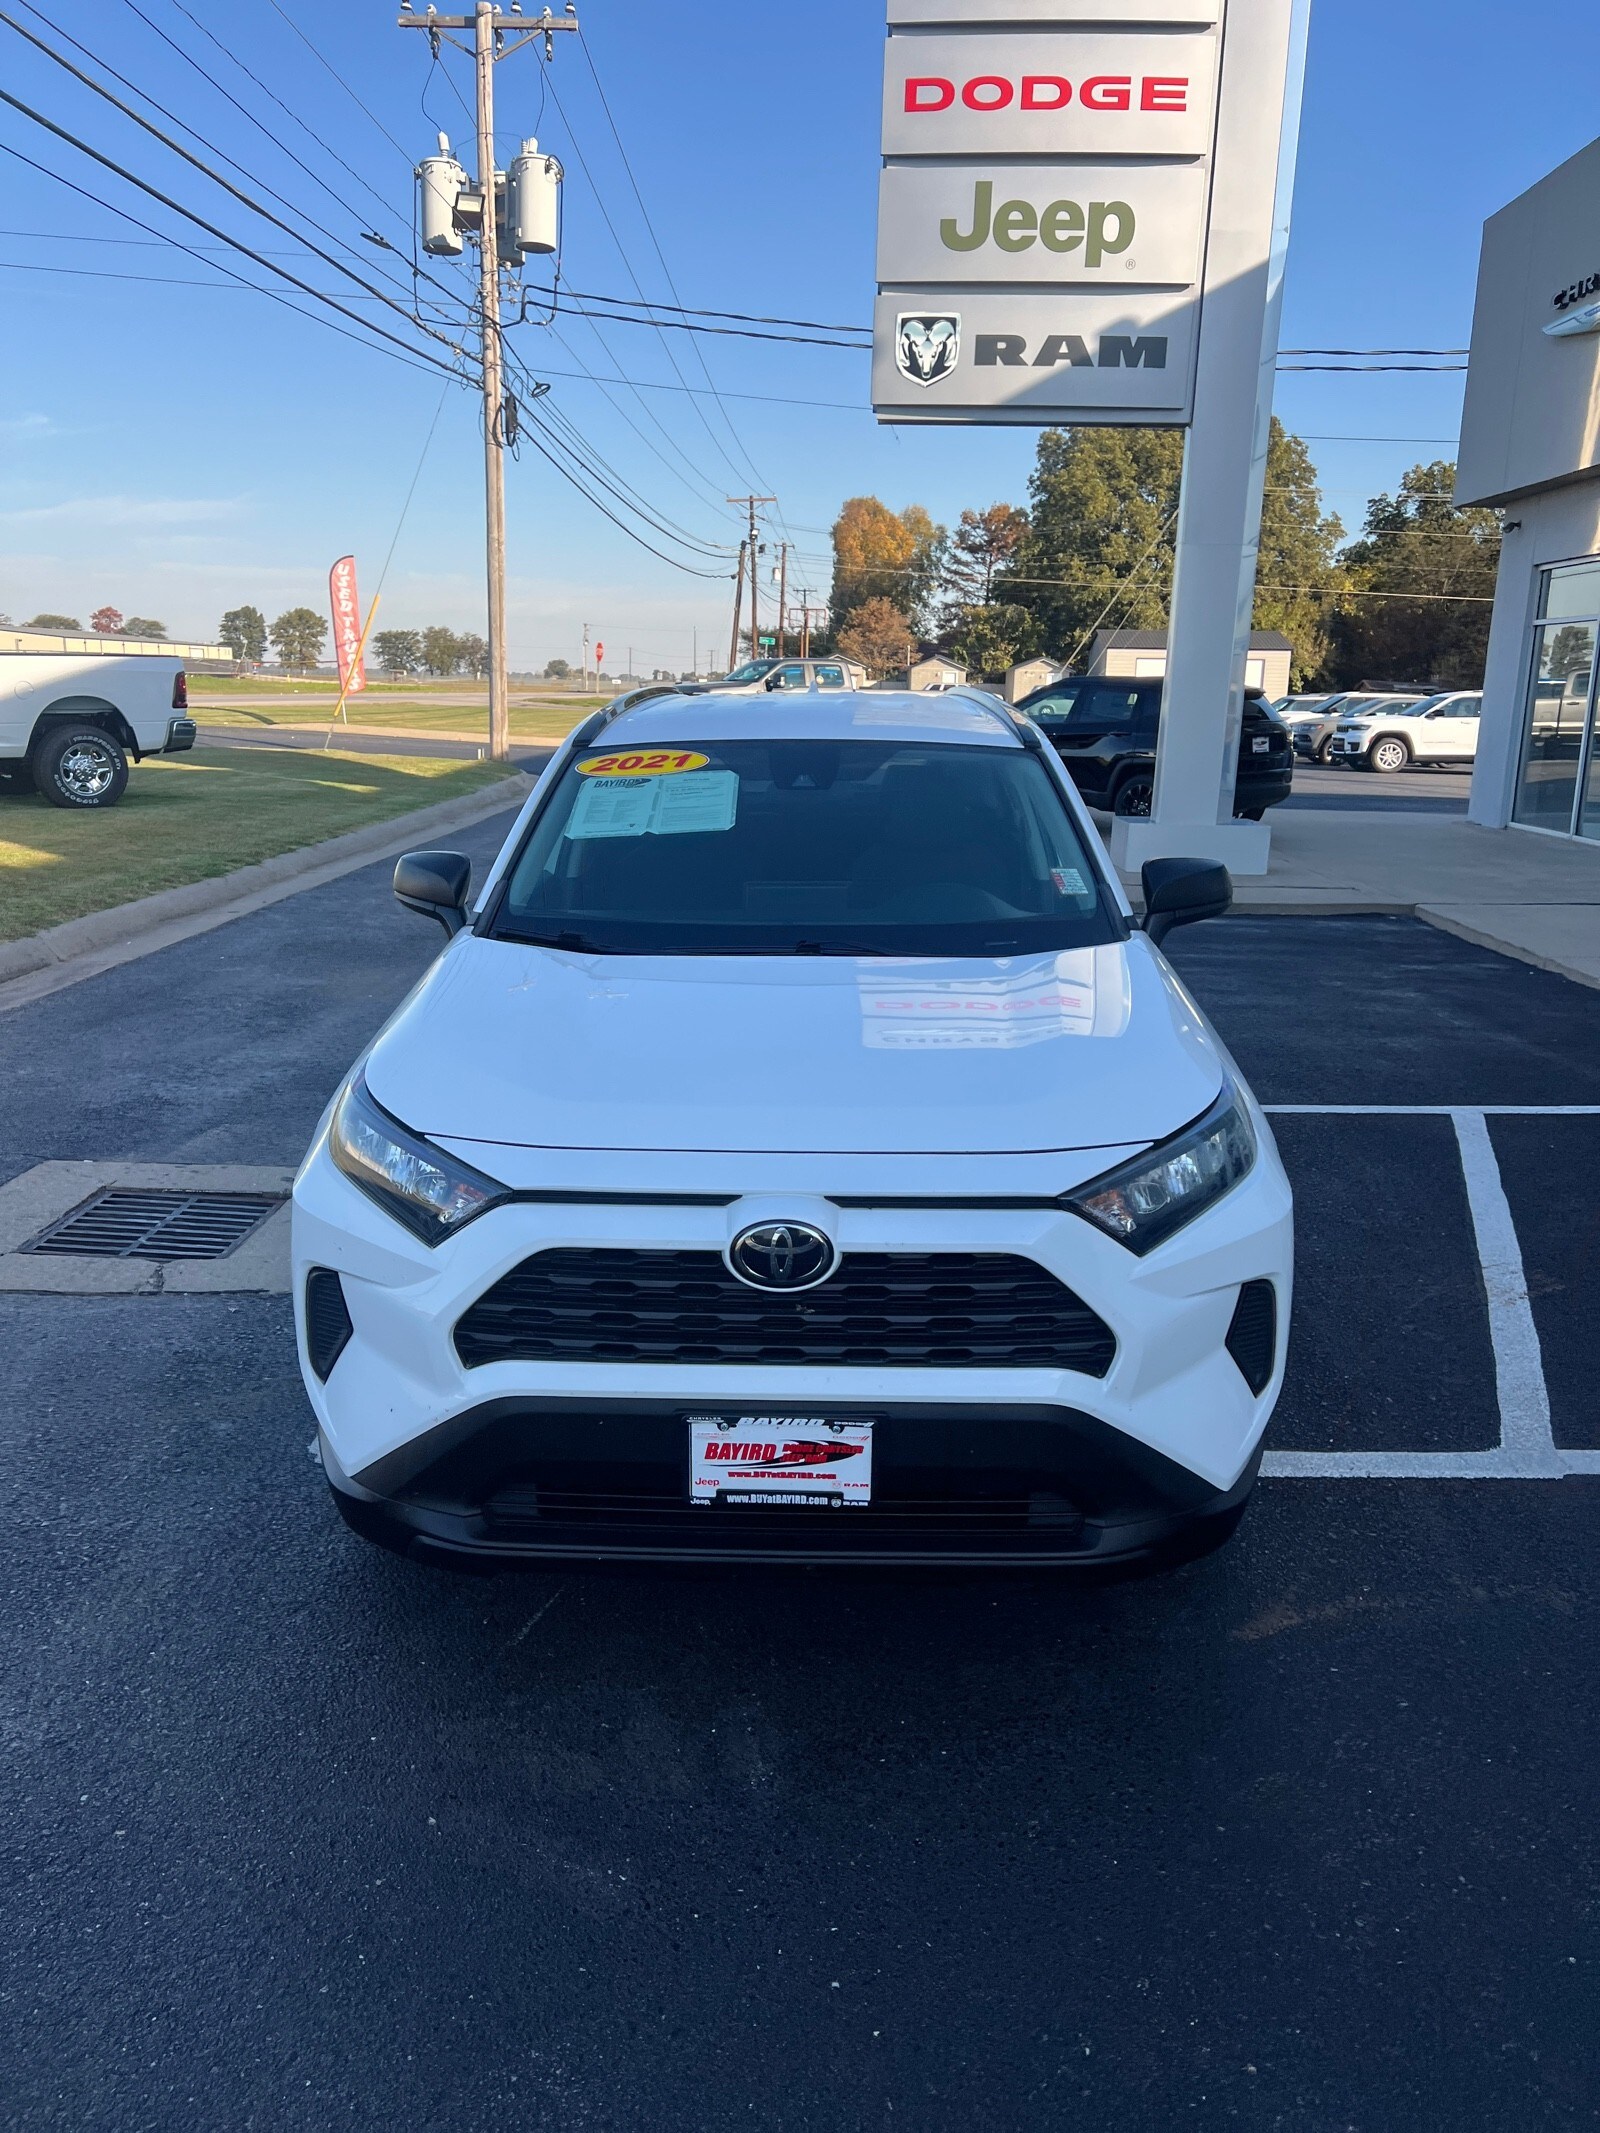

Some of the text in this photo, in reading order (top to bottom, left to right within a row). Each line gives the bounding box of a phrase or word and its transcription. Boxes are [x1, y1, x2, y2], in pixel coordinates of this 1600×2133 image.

[904, 76, 1189, 112] DODGE
[940, 181, 1135, 268] Jeep
[974, 334, 1168, 369] RAM
[337, 563, 353, 612] USED
[588, 754, 693, 773] 2021
[737, 1417, 825, 1426] BAYIRD
[704, 1442, 777, 1461] BAYIRD
[695, 1477, 720, 1486] Jeep
[726, 1494, 829, 1505] www.BUYatBAYIRD.com
